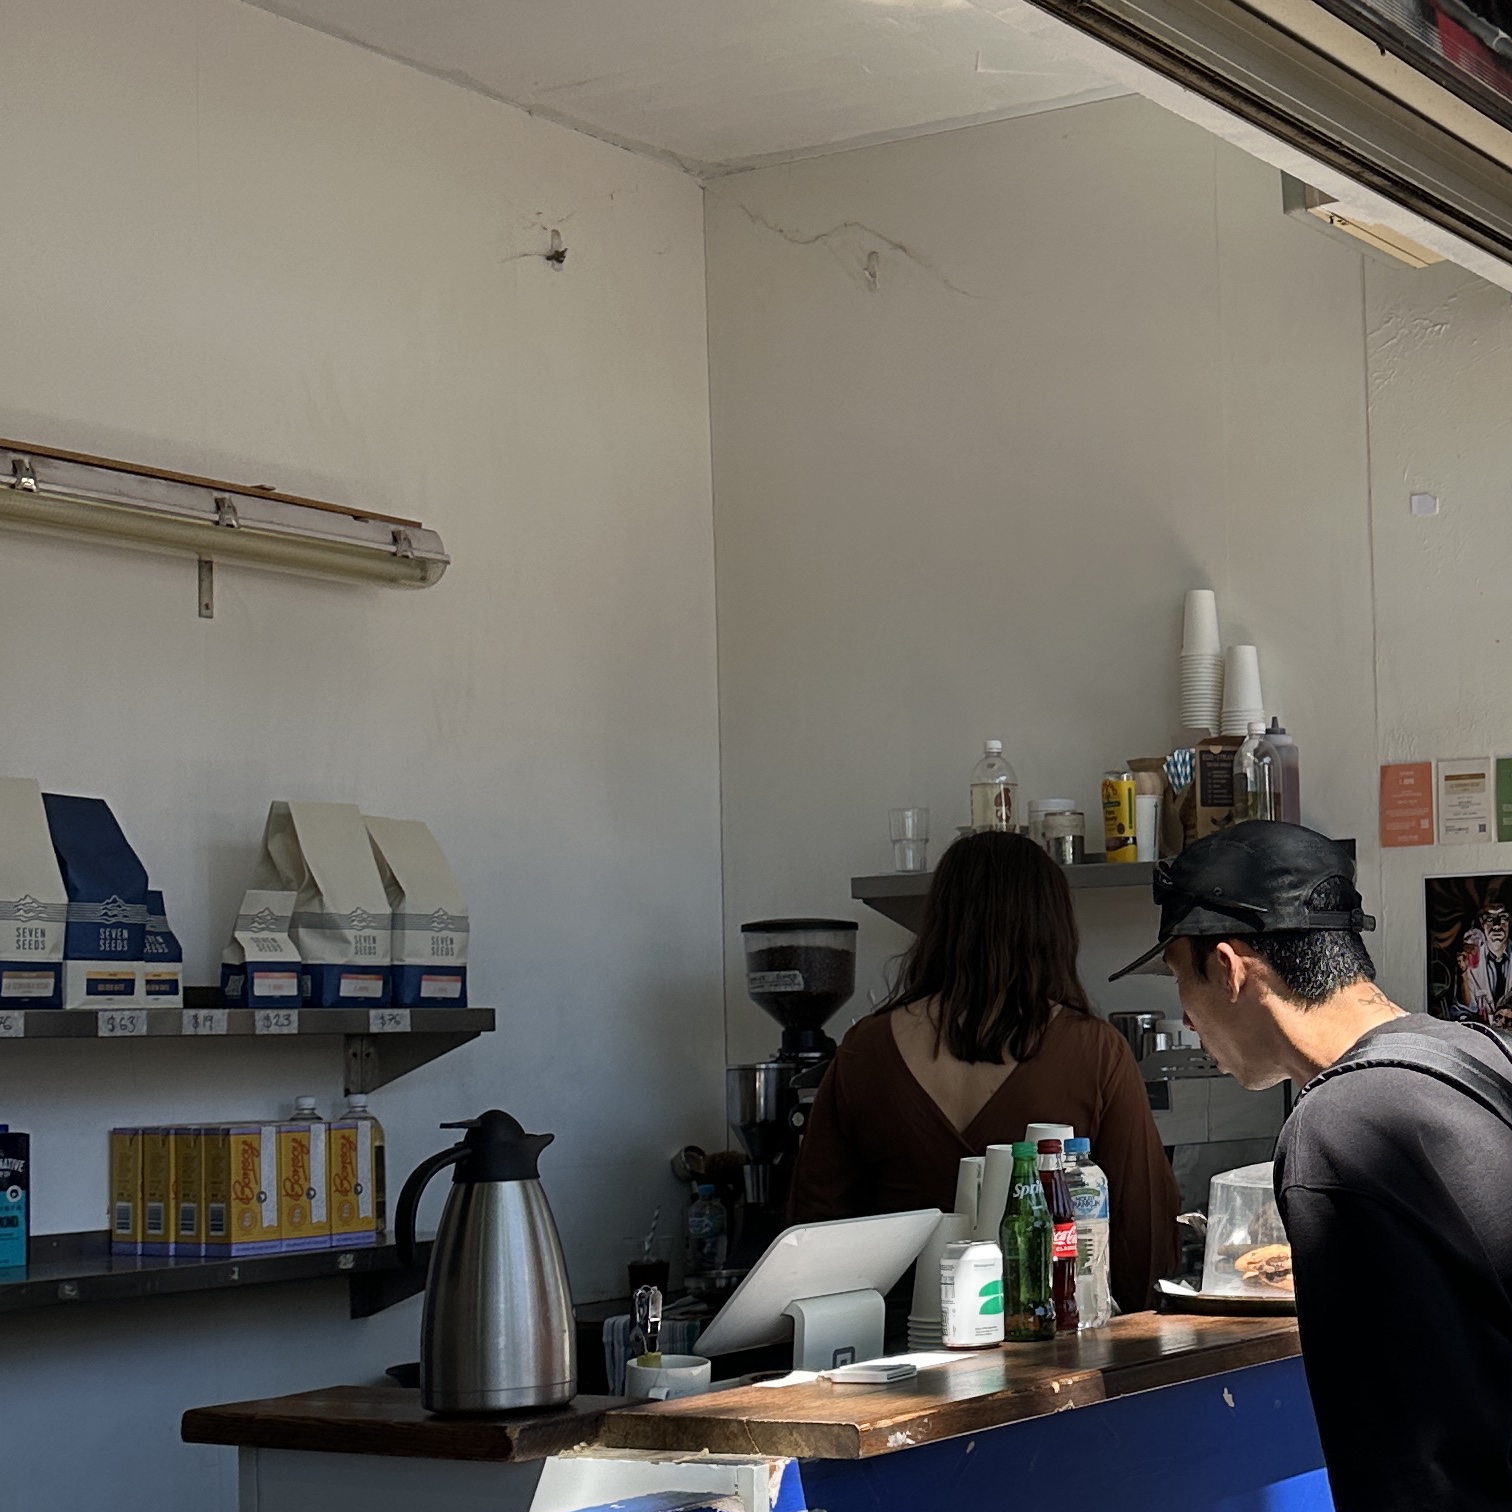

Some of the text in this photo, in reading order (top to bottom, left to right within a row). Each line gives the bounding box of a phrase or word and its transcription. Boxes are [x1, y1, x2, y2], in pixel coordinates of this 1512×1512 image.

[15, 927, 46, 938] SEVEN
[99, 928, 129, 939] SEVEN
[15, 939, 46, 950] SEEDS
[99, 940, 129, 951] SEEDS
